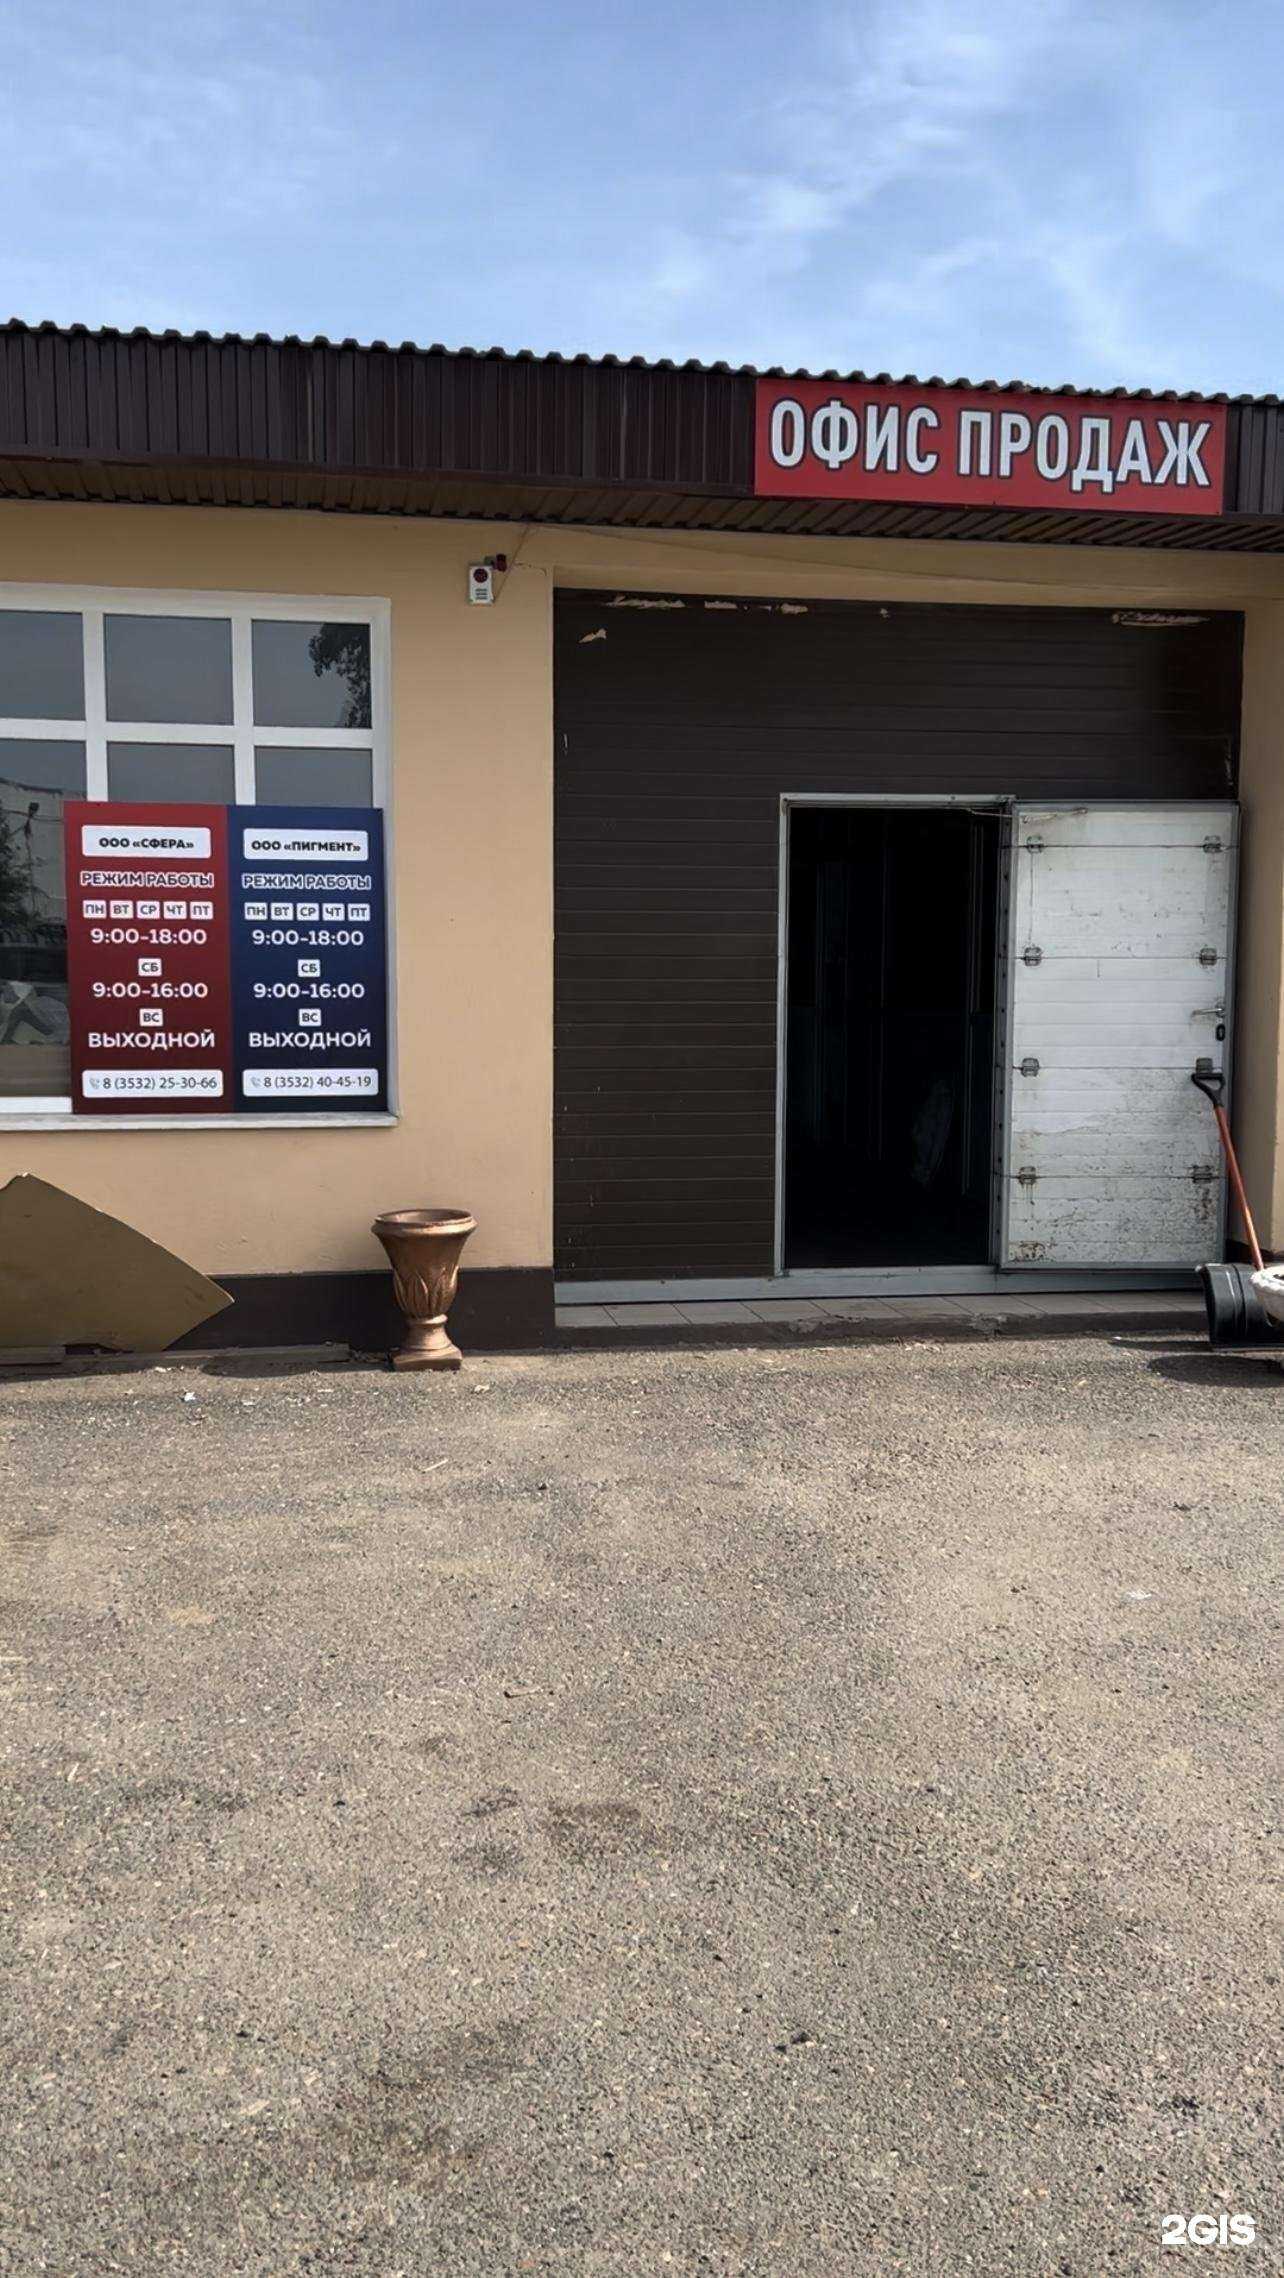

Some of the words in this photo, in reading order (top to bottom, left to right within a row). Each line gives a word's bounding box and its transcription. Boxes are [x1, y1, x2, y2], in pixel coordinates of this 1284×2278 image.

[769, 398, 940, 475] ОФИС
[958, 409, 1213, 494] ПРОДАЖ
[99, 837, 130, 848] ООО
[132, 837, 194, 850] «СФЕРА»
[251, 840, 281, 851] ООО
[284, 841, 361, 852] «ПИГМЕНТ»
[81, 871, 144, 888] РЕЖИМ
[146, 873, 214, 888] РАБОТЫ
[242, 873, 305, 890] РЕЖИМ
[305, 874, 371, 890] РАБОТЫ
[85, 904, 105, 916] ПН
[113, 904, 130, 915] ВТ
[140, 905, 157, 916] СР
[166, 905, 183, 916] ЧТ
[192, 905, 210, 916] ПТ
[247, 906, 266, 917] ПН
[274, 906, 289, 917] ВТ
[300, 906, 316, 918] СР
[325, 907, 342, 918] ЧТ
[350, 907, 367, 918] ПТ
[141, 962, 159, 972] СБ
[301, 963, 318, 973] СБ
[143, 1012, 160, 1023] ВС
[302, 1012, 318, 1023] ВС
[88, 1029, 215, 1050] ВЫХОДНОЙ
[249, 1029, 371, 1050] ВЫХОДНОЙ
[102, 1078, 111, 1089] 8
[114, 1077, 156, 1090] (3532)
[159, 1078, 218, 1089] 25-30-66
[263, 1077, 271, 1088] 8
[274, 1077, 314, 1090] (3532)
[317, 1077, 371, 1088] 40-45-19
